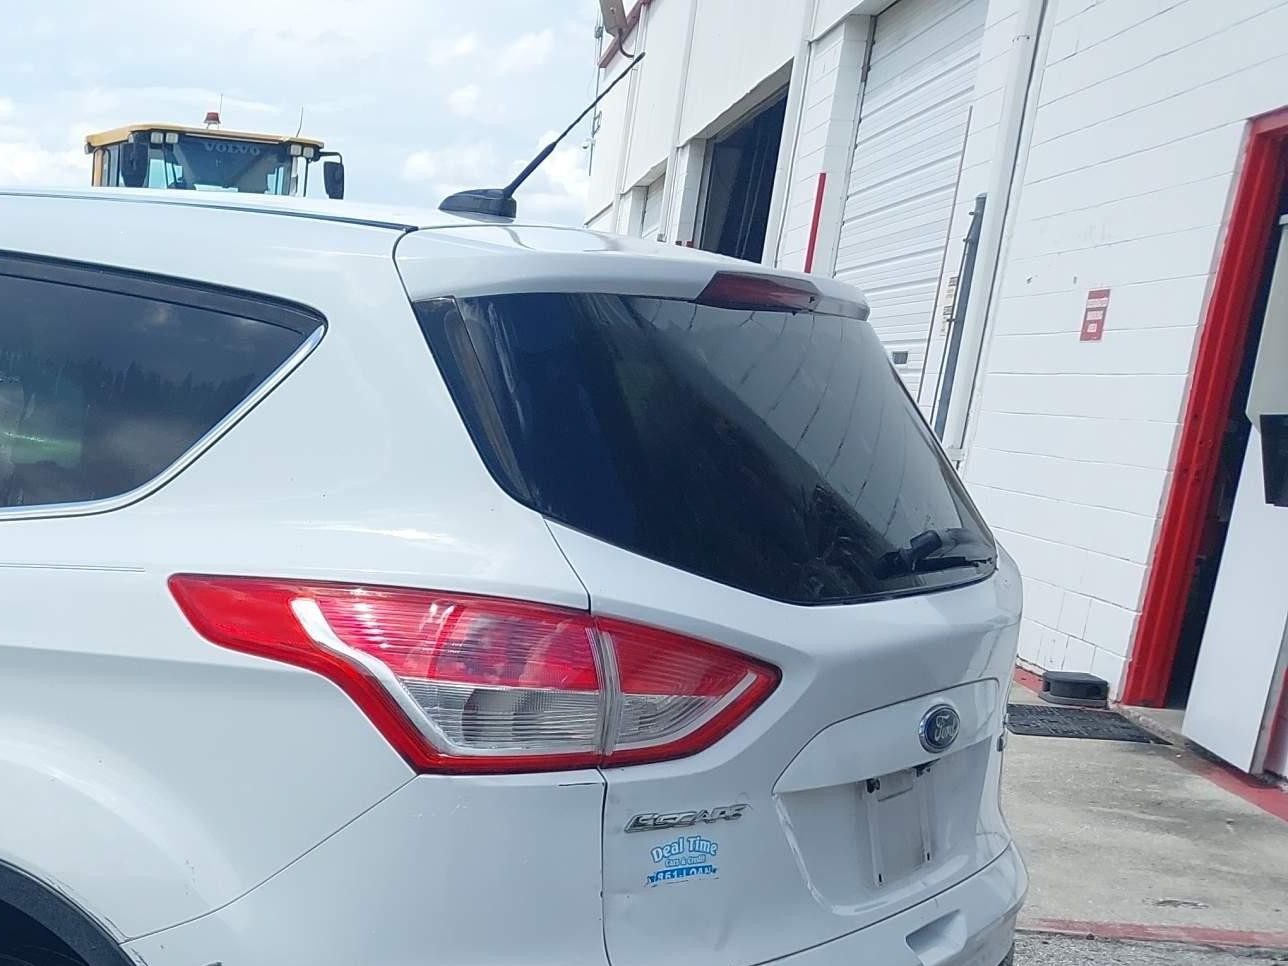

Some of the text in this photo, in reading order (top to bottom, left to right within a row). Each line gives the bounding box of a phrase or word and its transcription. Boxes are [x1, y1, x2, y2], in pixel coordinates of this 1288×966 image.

[203, 142, 261, 156] VOLVO
[933, 713, 958, 742] Ford
[623, 803, 752, 834] ESCAPE
[650, 835, 719, 863] Deal Time
